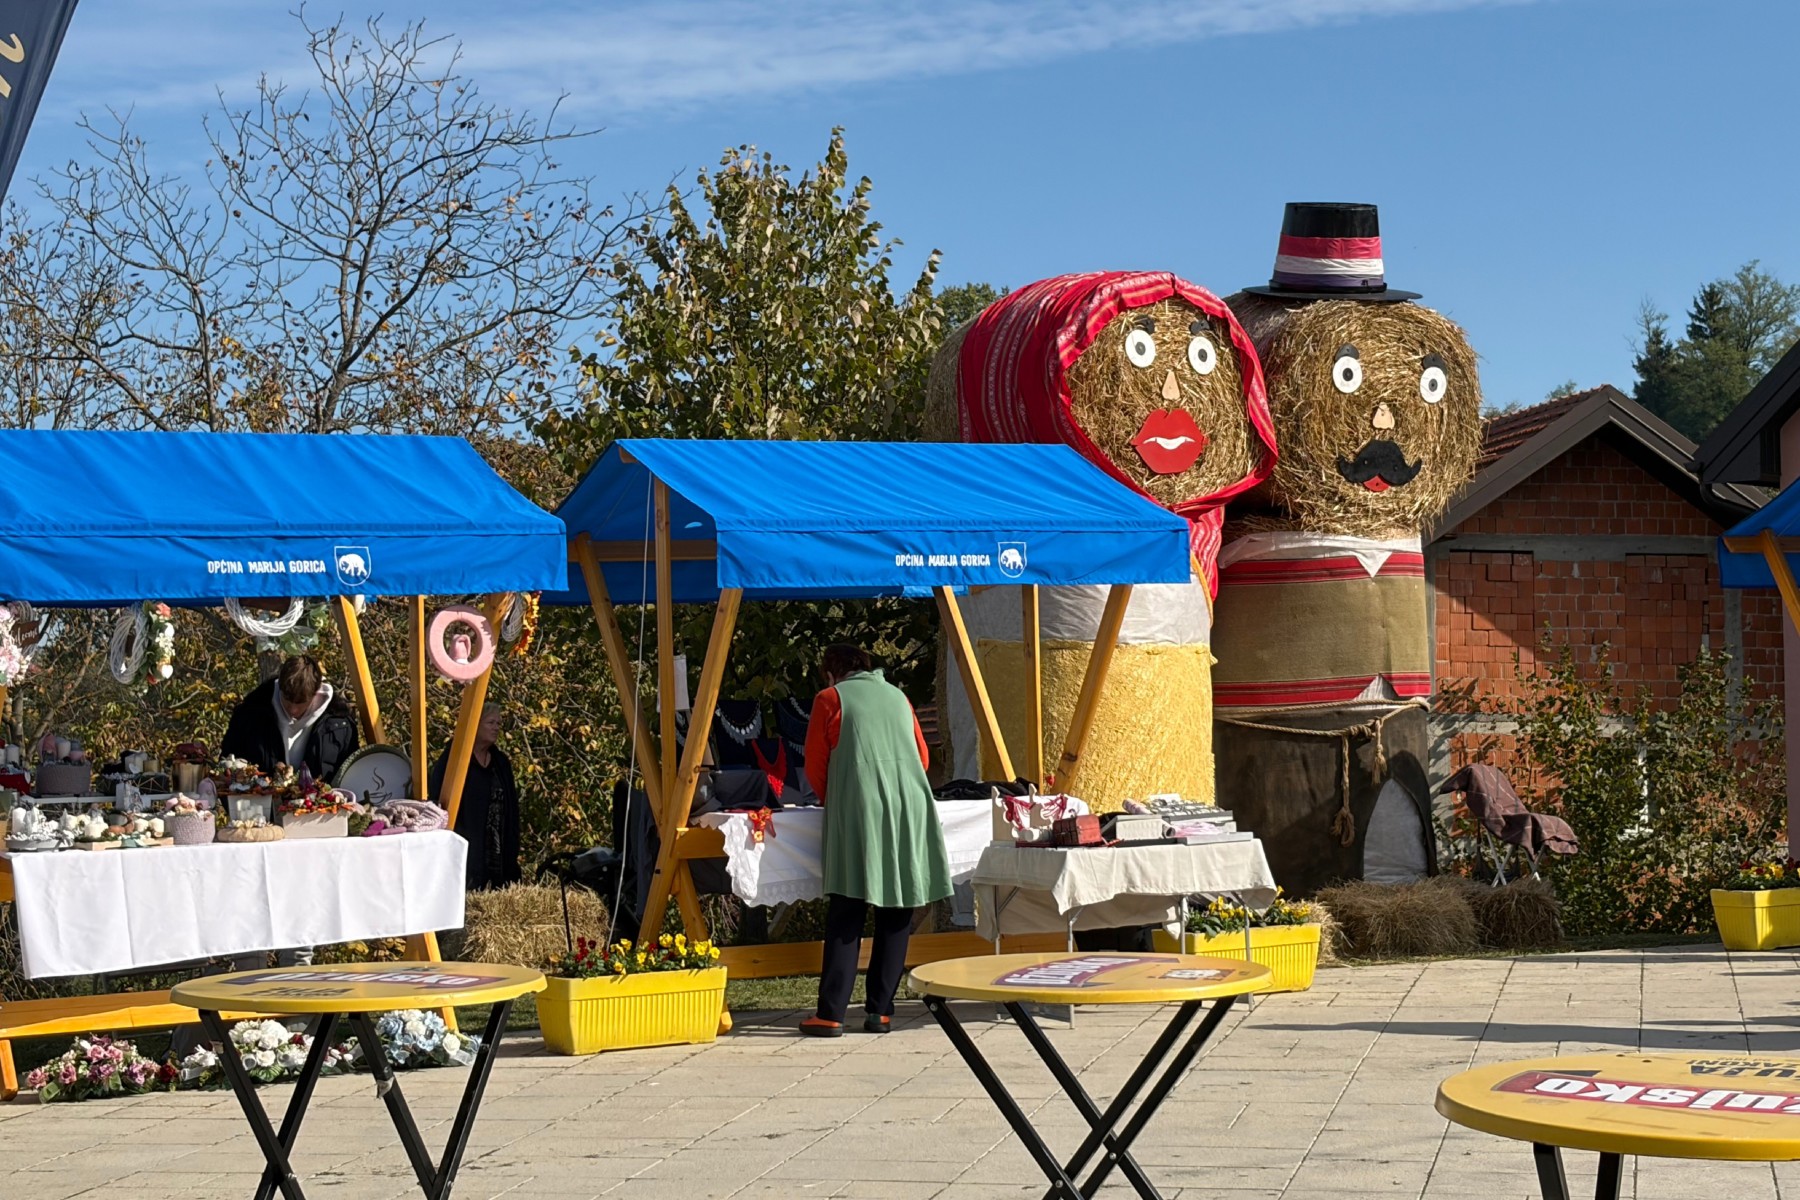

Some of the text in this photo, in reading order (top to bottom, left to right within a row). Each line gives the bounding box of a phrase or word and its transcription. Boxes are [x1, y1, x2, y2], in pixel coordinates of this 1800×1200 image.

[248, 560, 286, 574] MARIJA
[289, 560, 326, 574] GORICA
[928, 554, 958, 567] MARIJA
[960, 554, 991, 567] GORICA
[1690, 1065, 1800, 1080] UJA
